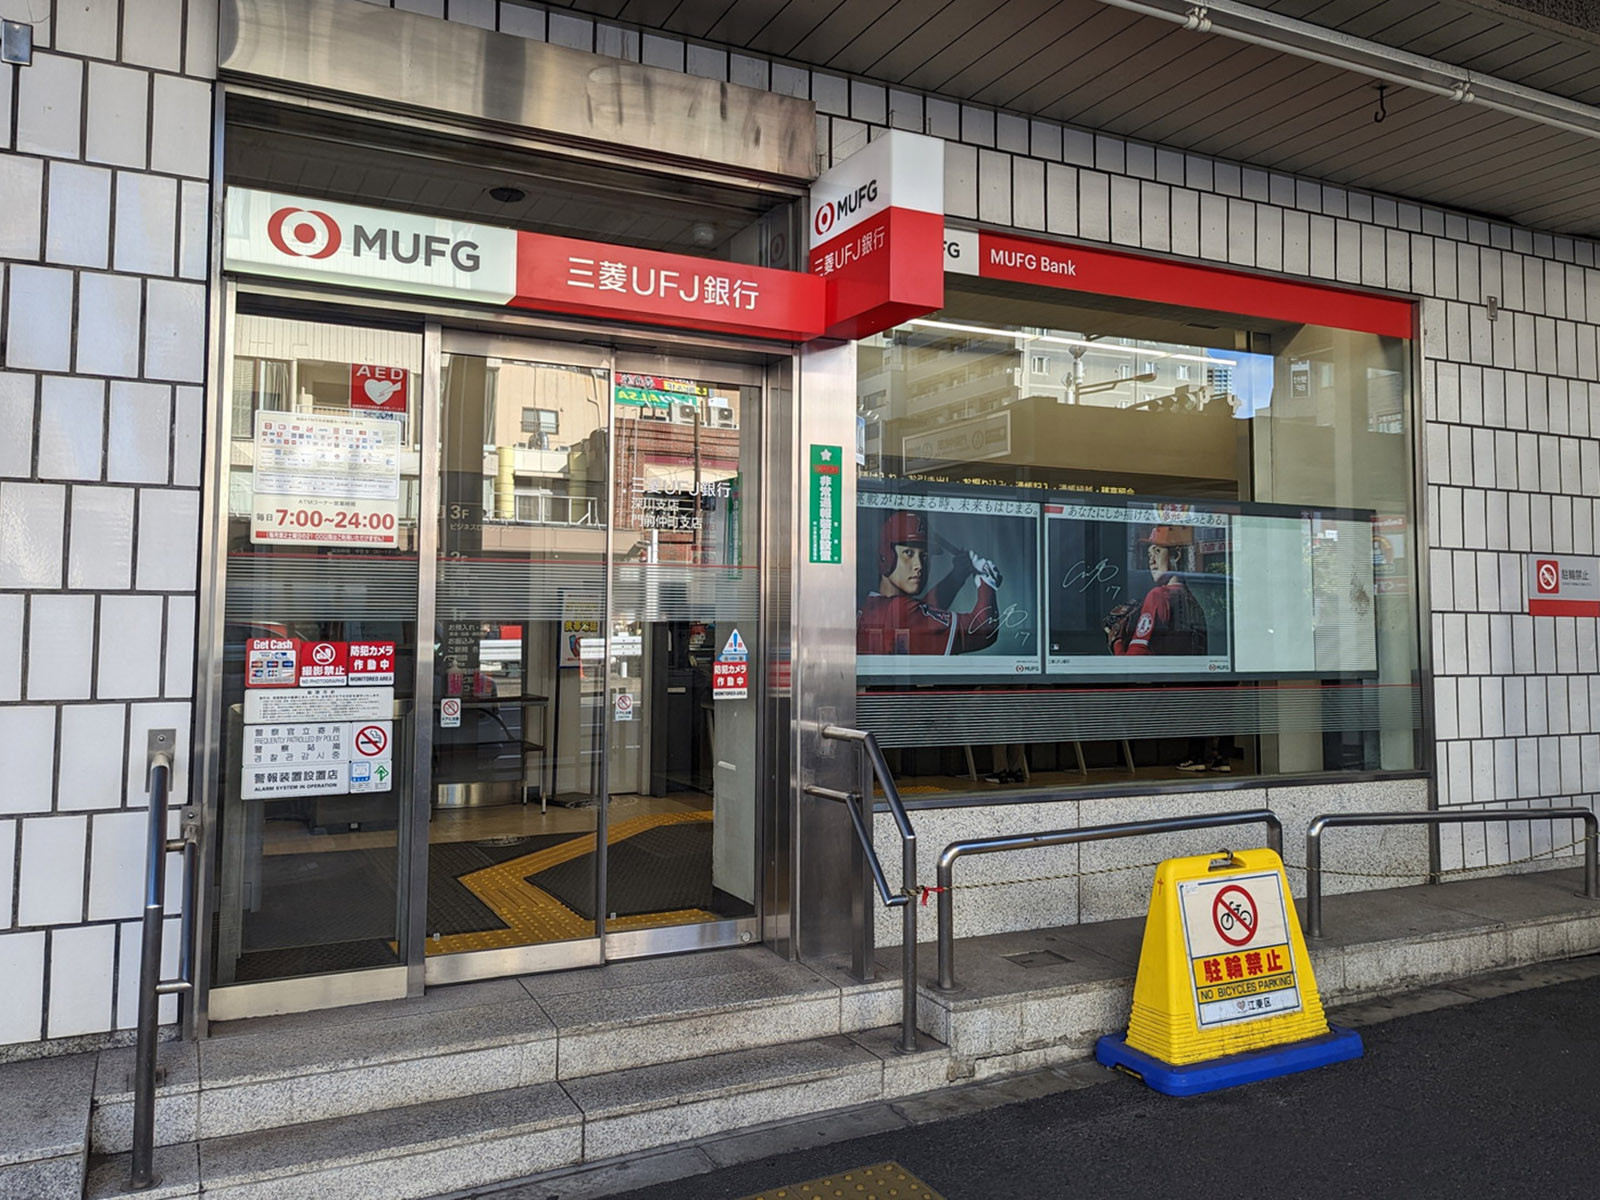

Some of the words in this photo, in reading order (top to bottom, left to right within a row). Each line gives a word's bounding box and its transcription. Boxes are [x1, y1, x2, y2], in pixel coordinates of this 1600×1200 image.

[837, 179, 878, 221] MUFG
[353, 224, 481, 273] MUFG
[814, 226, 885, 277] 三菱UFJ銀行
[990, 249, 1037, 270] MUFG
[1040, 257, 1076, 276] Bank
[567, 256, 759, 310] 三菱UFJ銀行
[356, 365, 404, 380] AED
[631, 477, 732, 498] 三菱UFJ銀行
[256, 512, 273, 522] 毎日
[450, 505, 470, 519] 3F
[253, 640, 269, 650] Get
[270, 640, 293, 650] Cash
[350, 645, 394, 657] 防犯カメラ
[301, 665, 345, 676] 撮影禁止
[354, 659, 390, 670] 作動中
[714, 665, 747, 674] 防犯カメラ
[717, 676, 744, 686] 作動中
[254, 726, 341, 737] 警察官立寄所
[254, 769, 338, 784] 警報装置設置店
[1203, 949, 1283, 983] 駐輪禁止
[1201, 990, 1214, 1000] NO
[1217, 982, 1257, 998] BICYCLES
[1258, 976, 1292, 991] PARKING
[1248, 997, 1272, 1011] 江東区
